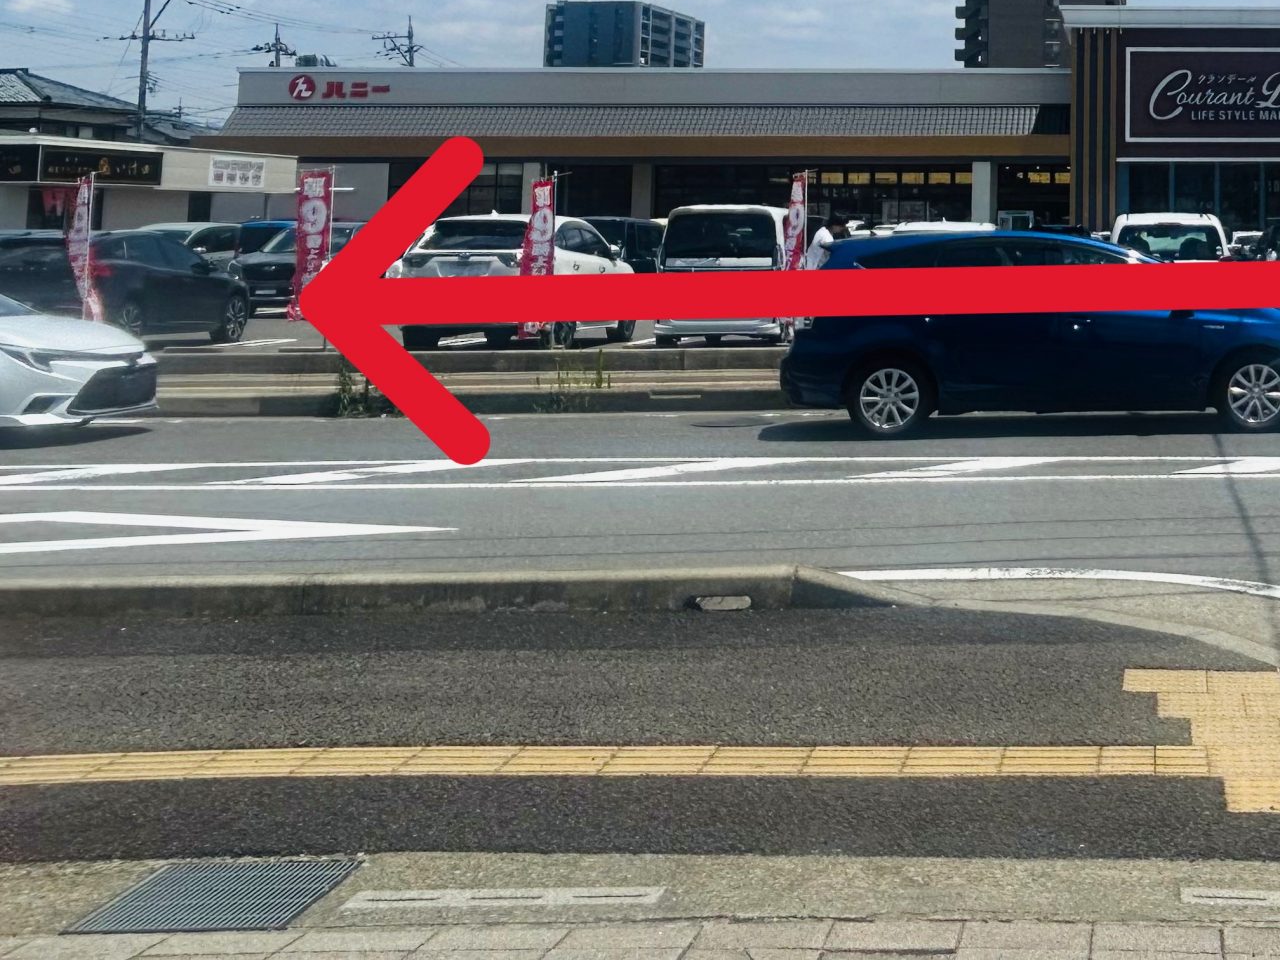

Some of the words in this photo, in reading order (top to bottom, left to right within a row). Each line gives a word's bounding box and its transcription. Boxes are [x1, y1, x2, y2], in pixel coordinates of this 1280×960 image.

[321, 81, 390, 99] ハニー
[1150, 69, 1254, 120] Courant
[1191, 110, 1215, 121] LIFE
[1219, 110, 1255, 121] STYLE
